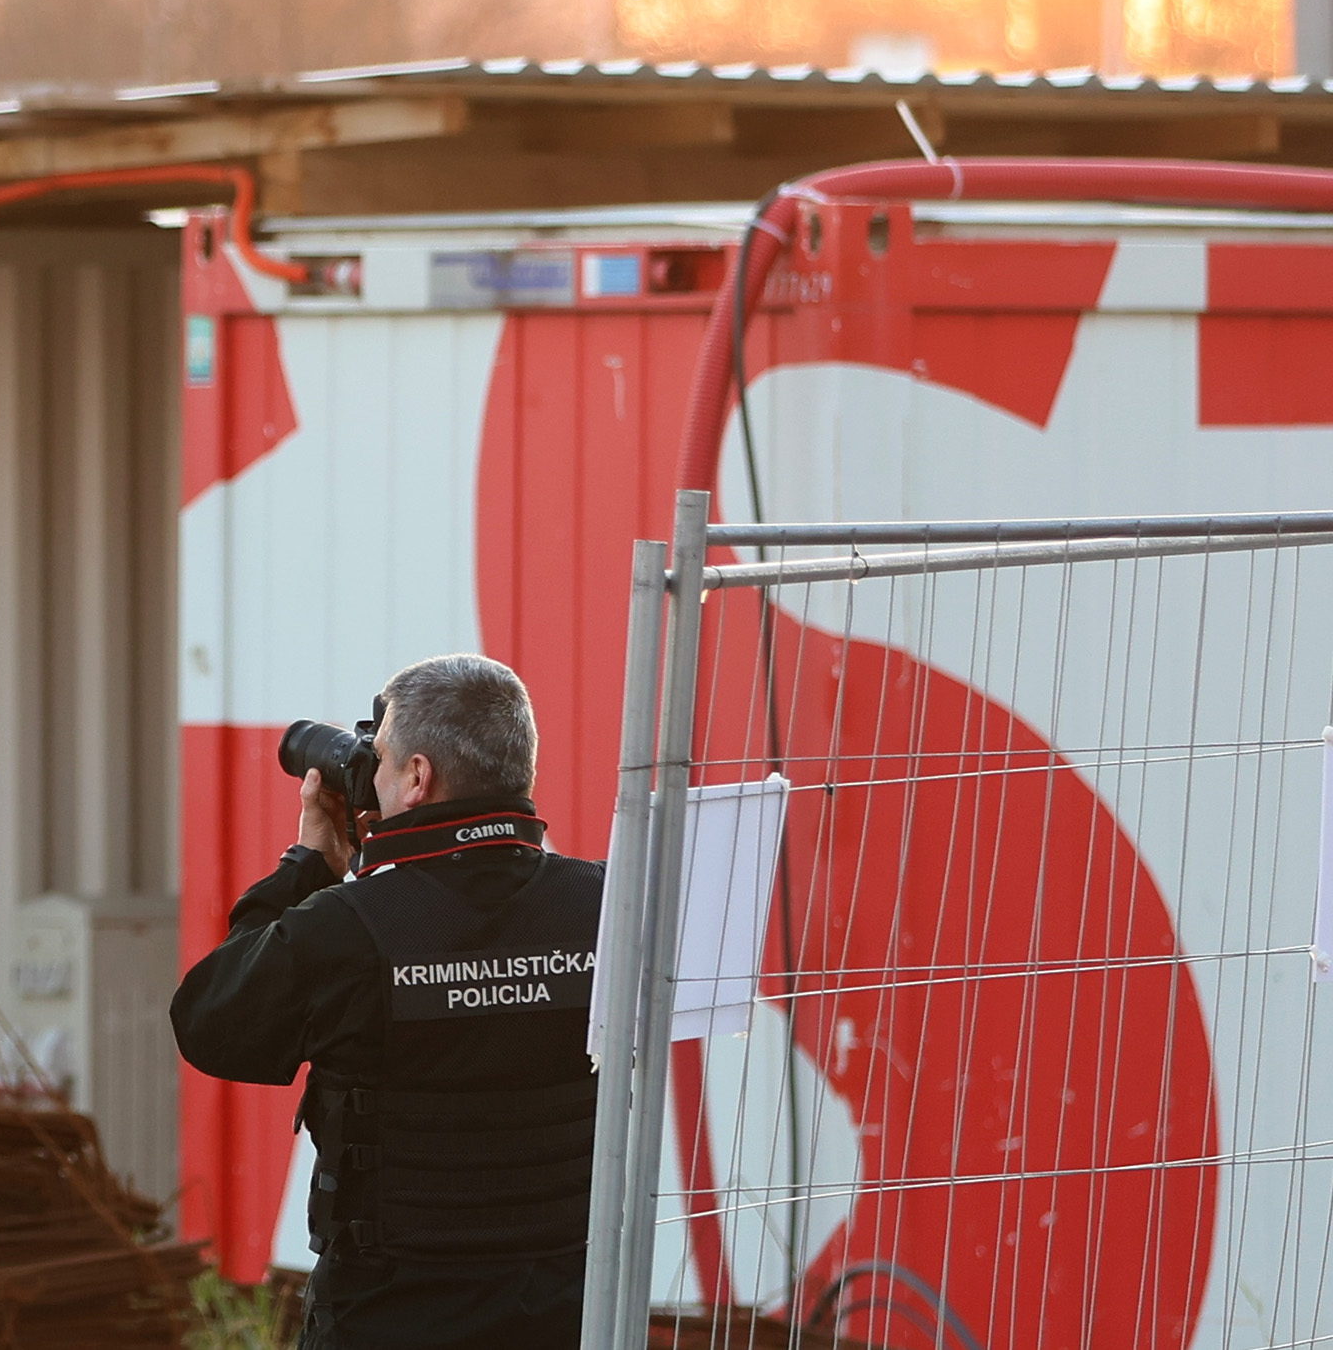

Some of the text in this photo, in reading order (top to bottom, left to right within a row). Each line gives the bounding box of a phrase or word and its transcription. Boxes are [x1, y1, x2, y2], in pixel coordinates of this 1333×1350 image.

[455, 822, 515, 842] Canon
[393, 950, 597, 986] KRIMINALISTIČKA
[447, 983, 551, 1009] POLICIJA
